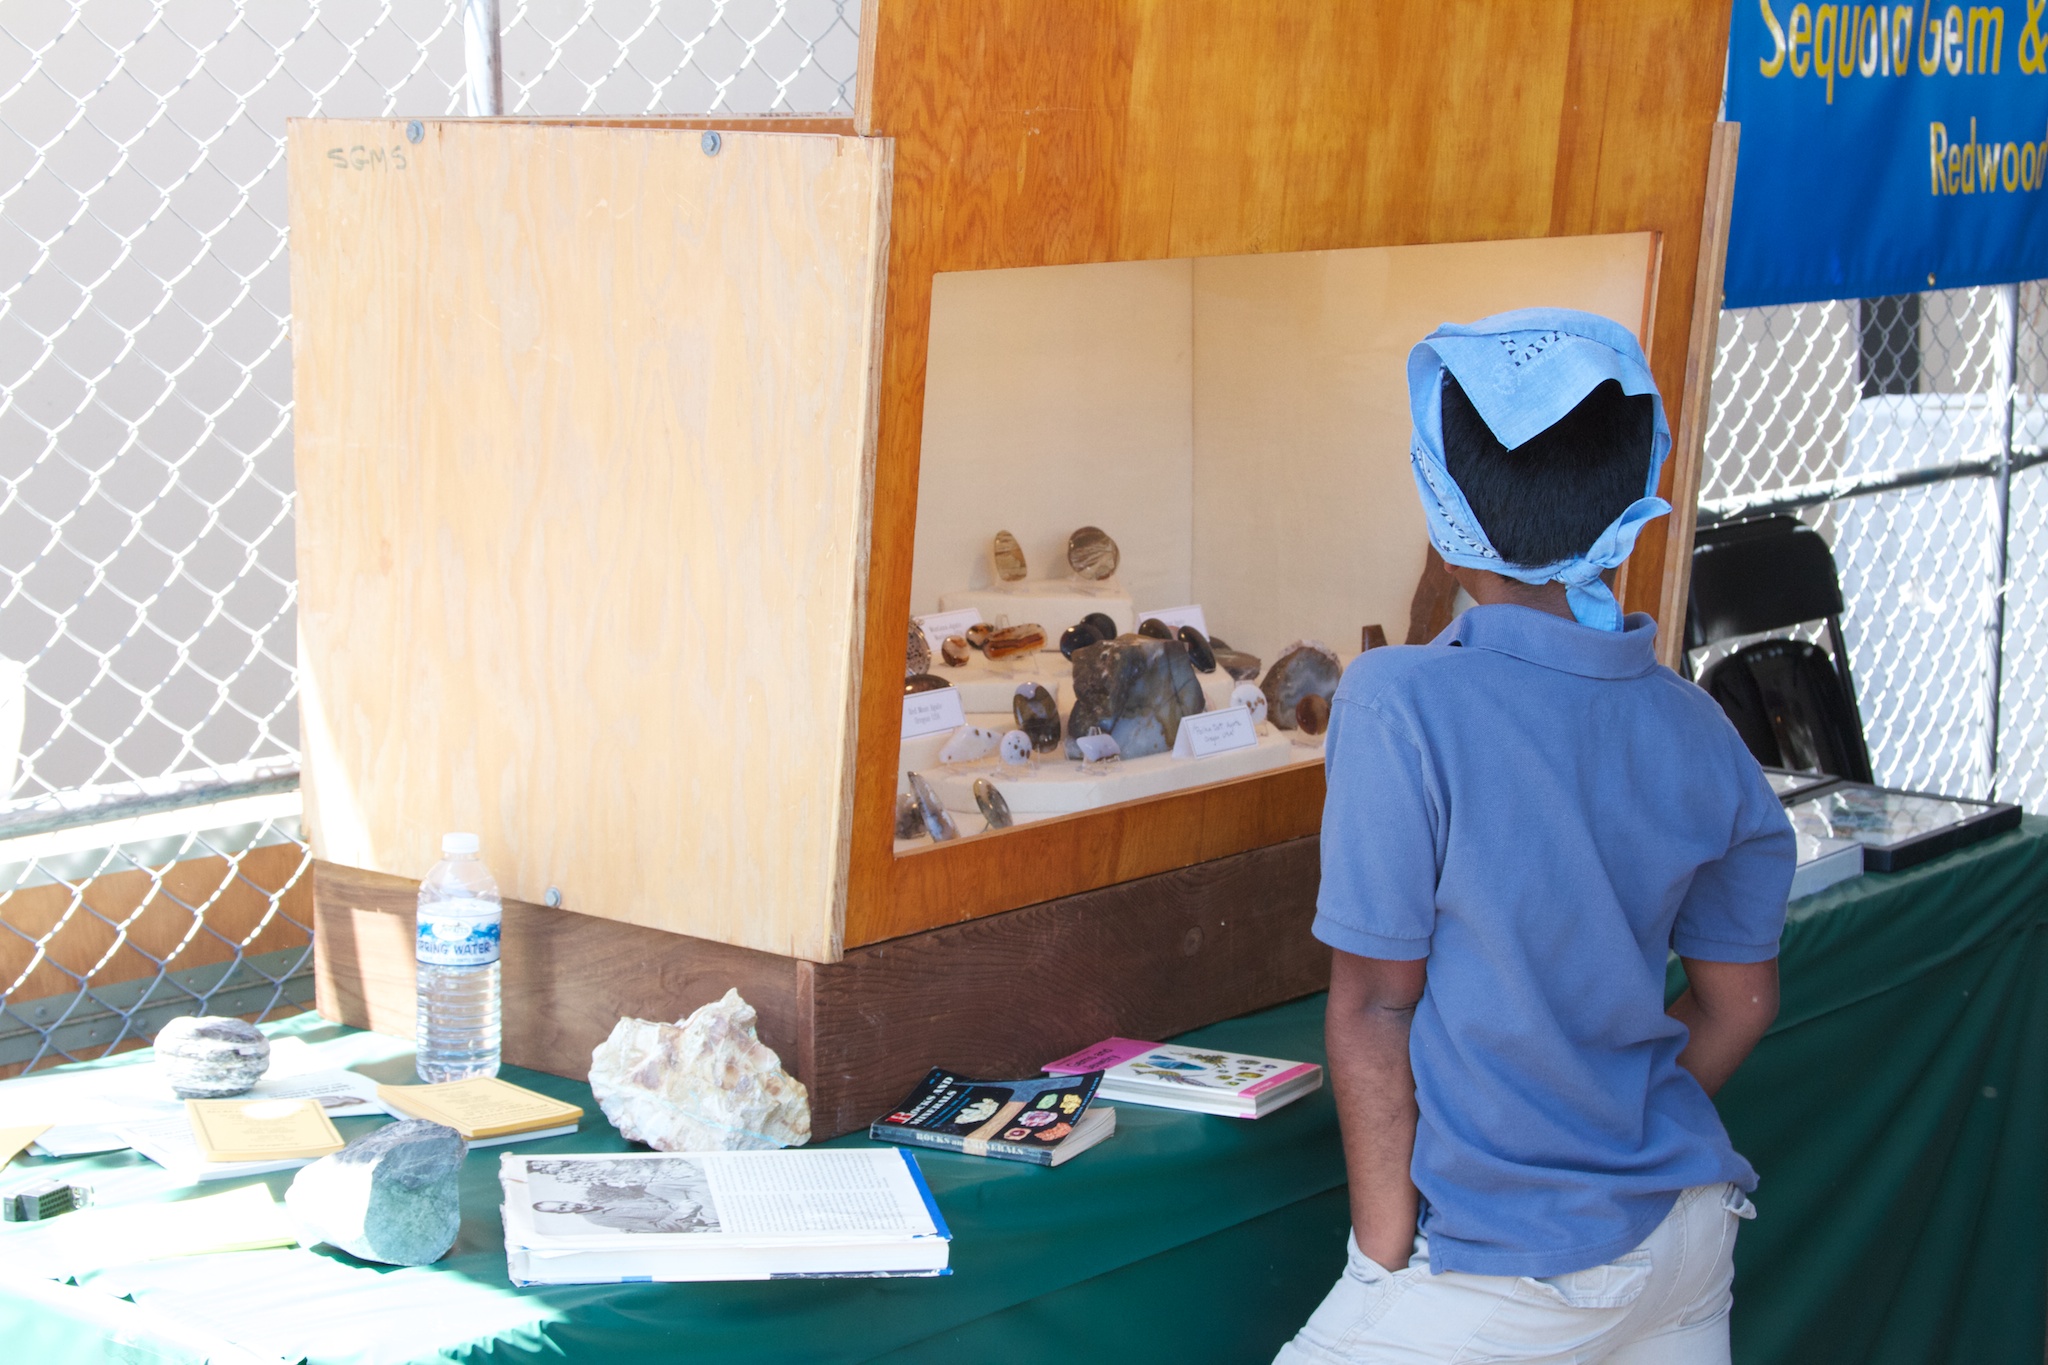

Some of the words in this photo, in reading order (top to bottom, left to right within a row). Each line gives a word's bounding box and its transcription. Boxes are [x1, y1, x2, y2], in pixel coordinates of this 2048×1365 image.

[1760, 0, 1913, 104] Sequoia
[1918, 0, 2004, 76] Gem
[327, 145, 407, 172] SGMS
[453, 942, 491, 954] WATER
[885, 1095, 936, 1124] ROCKS
[932, 1076, 954, 1095] AND
[909, 1090, 957, 1125] MINERALS
[916, 1132, 950, 1145] ROCKS
